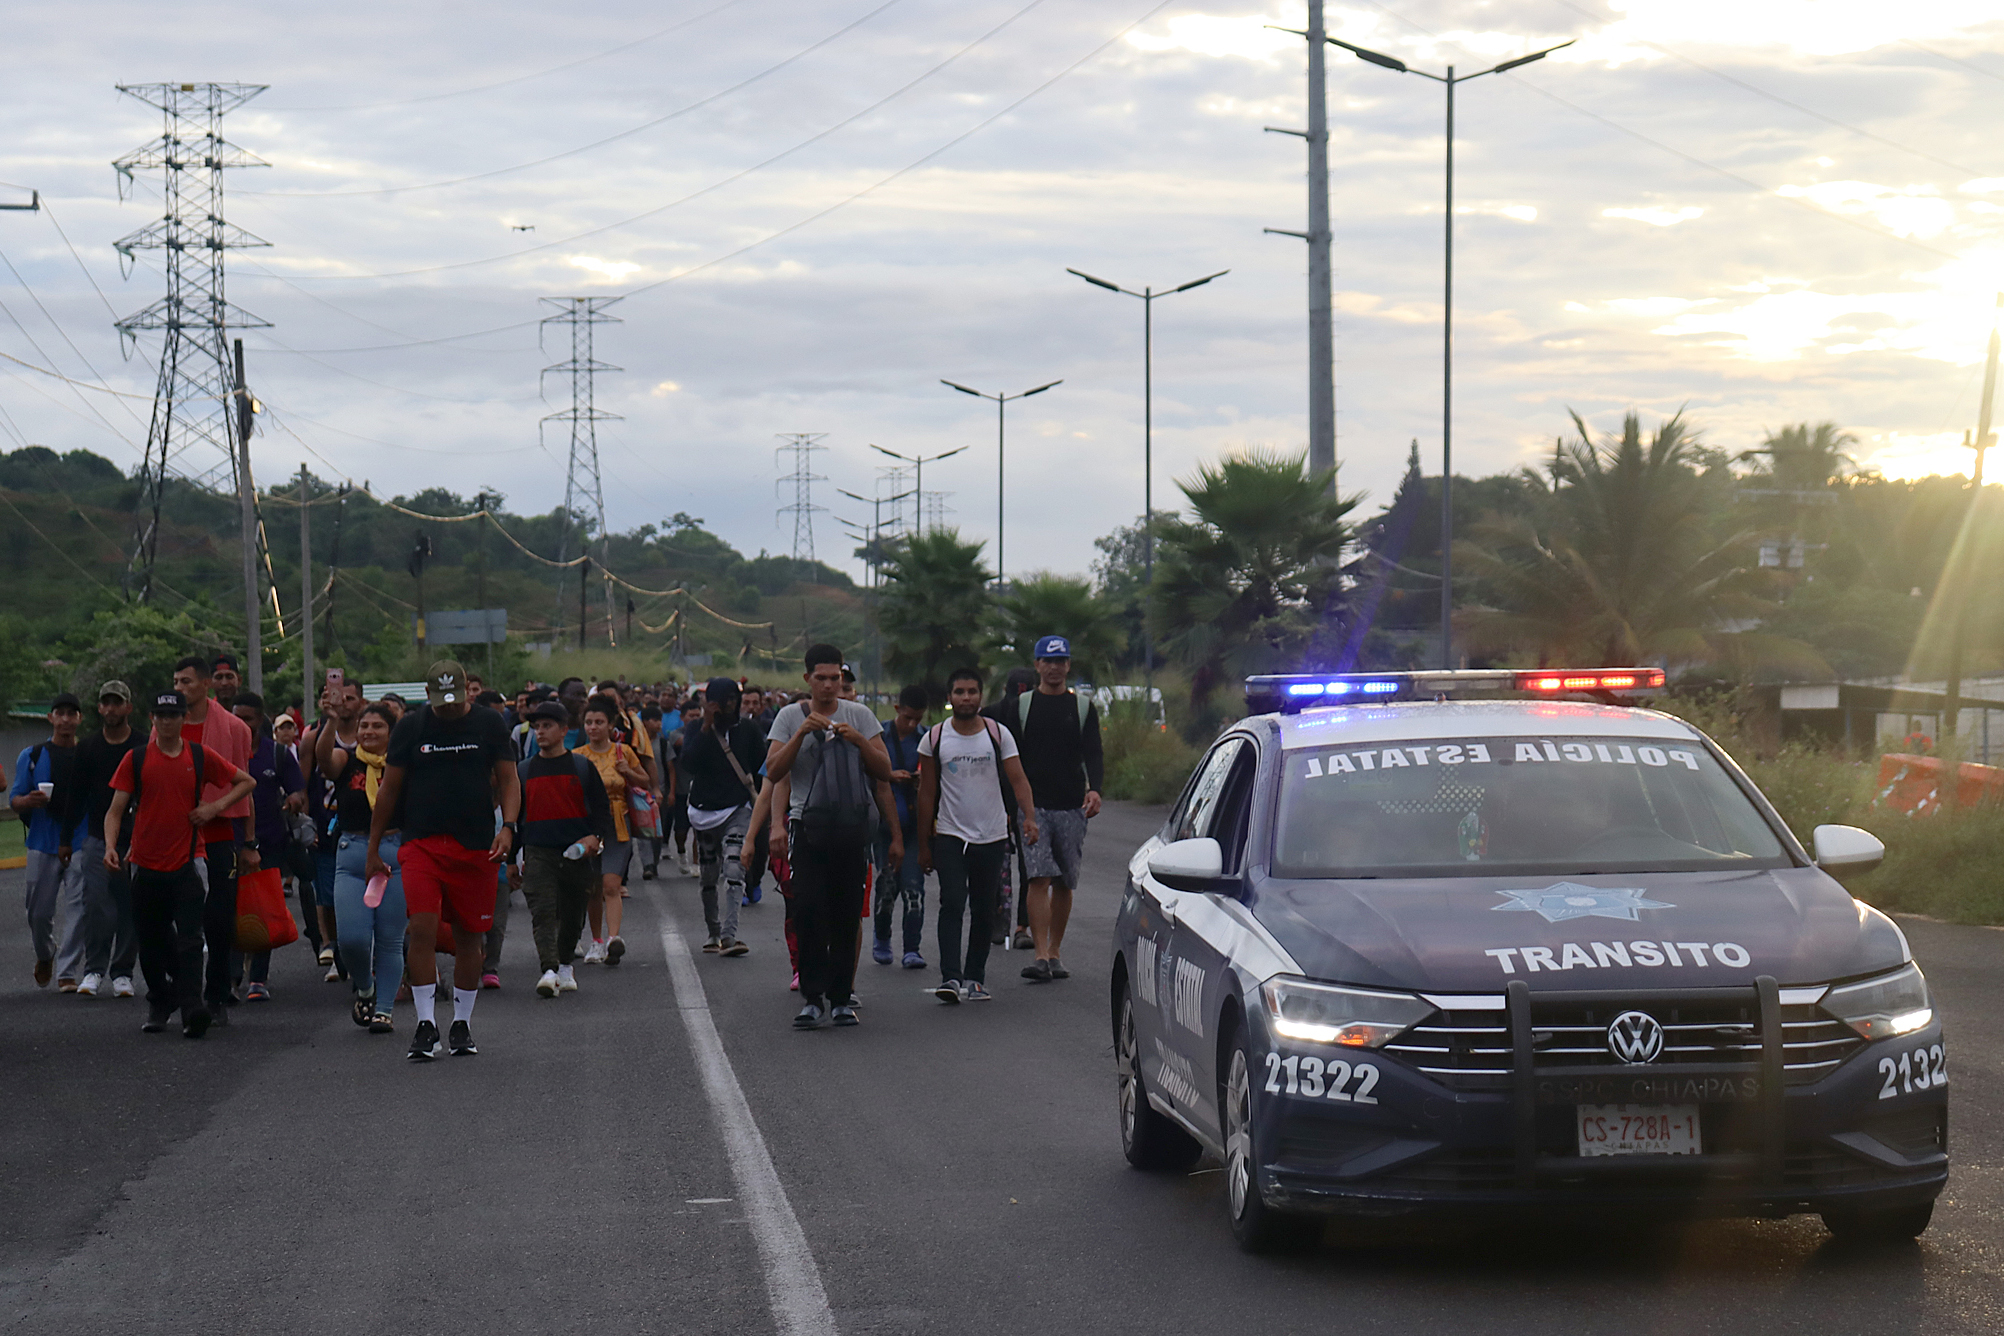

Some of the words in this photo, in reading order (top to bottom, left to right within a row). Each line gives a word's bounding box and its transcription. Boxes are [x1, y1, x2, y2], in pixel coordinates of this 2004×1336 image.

[420, 743, 479, 754] Champion
[1484, 940, 1751, 974] TRANSITO
[1265, 1052, 1380, 1105] 21322
[1878, 1042, 1950, 1100] 2132
[1630, 1078, 1758, 1100] CHIAPAS
[1583, 1114, 1694, 1142] CS-728A-1
